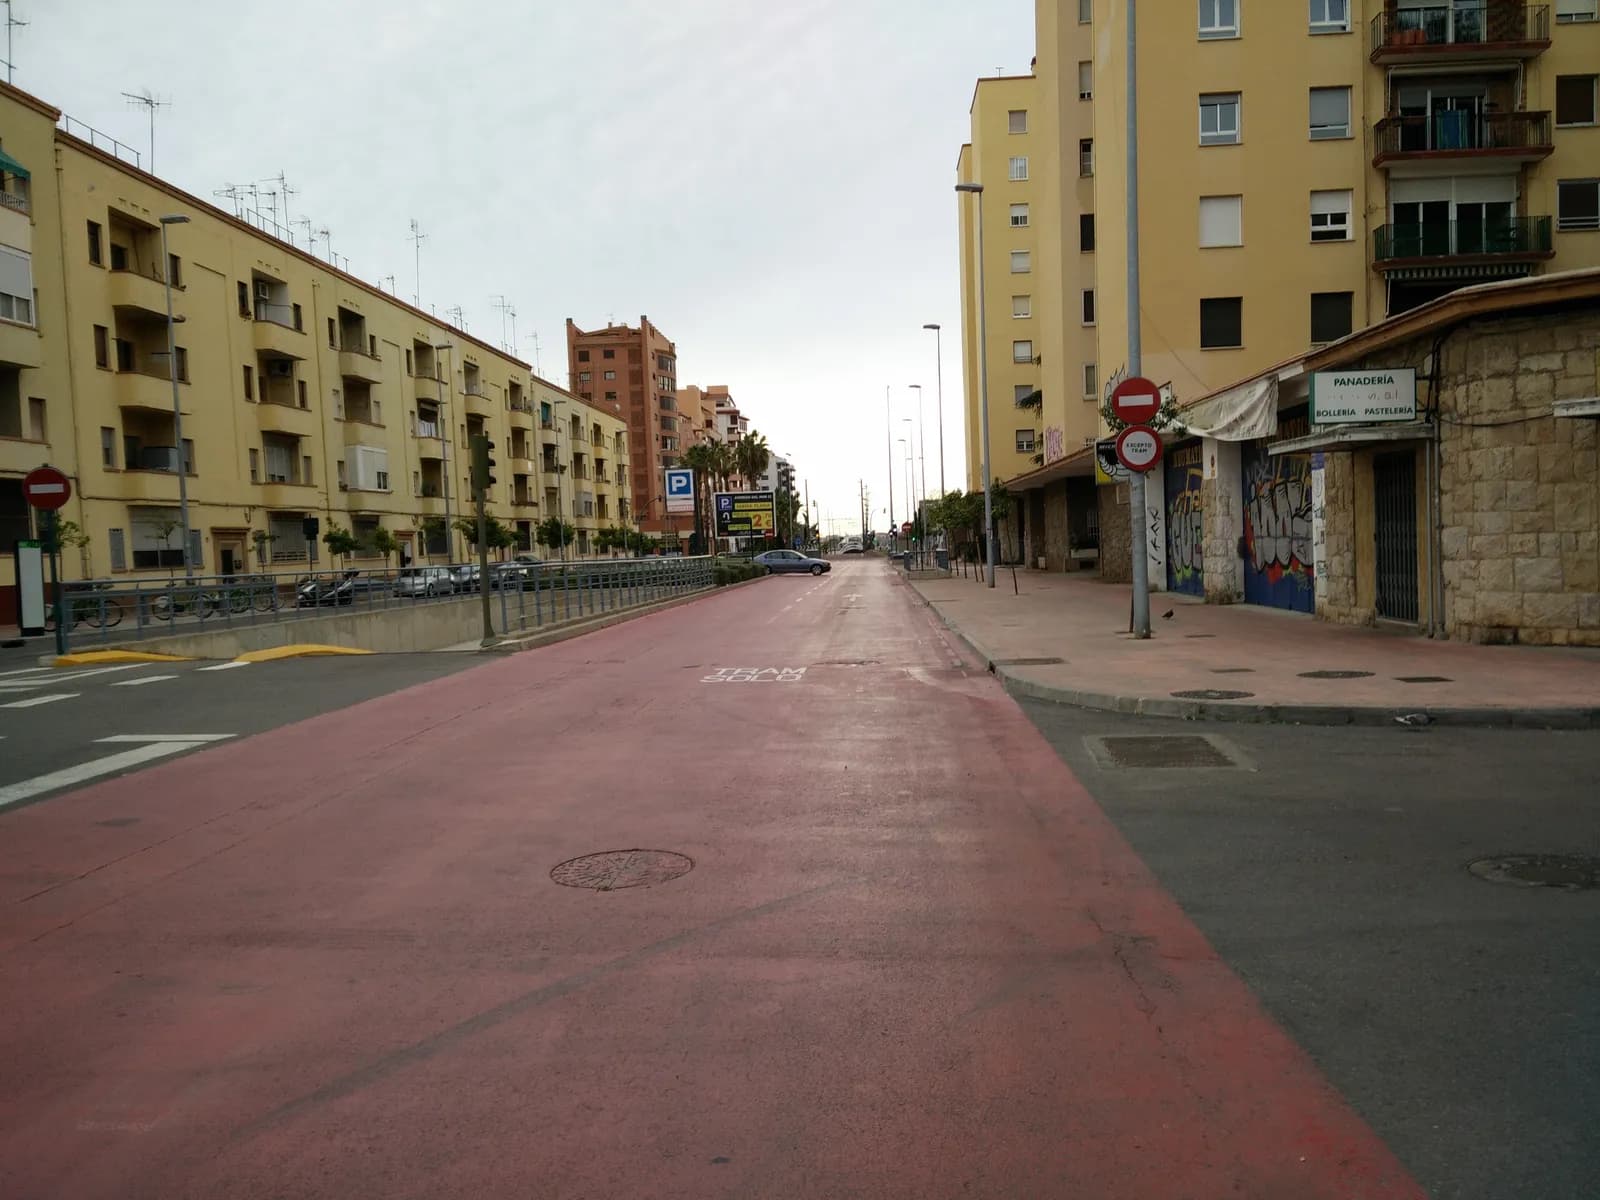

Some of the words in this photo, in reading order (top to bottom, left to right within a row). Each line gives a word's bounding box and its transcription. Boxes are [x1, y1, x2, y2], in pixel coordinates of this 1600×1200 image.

[1334, 374, 1394, 387] PANADERÍA
[1316, 408, 1356, 417] BOLLERÍA
[1364, 406, 1413, 415] PASTELERÍA
[671, 475, 687, 492] P
[721, 498, 729, 508] P
[752, 513, 762, 527] 2
[713, 667, 807, 675] TRAM
[700, 674, 801, 682] SOLO
